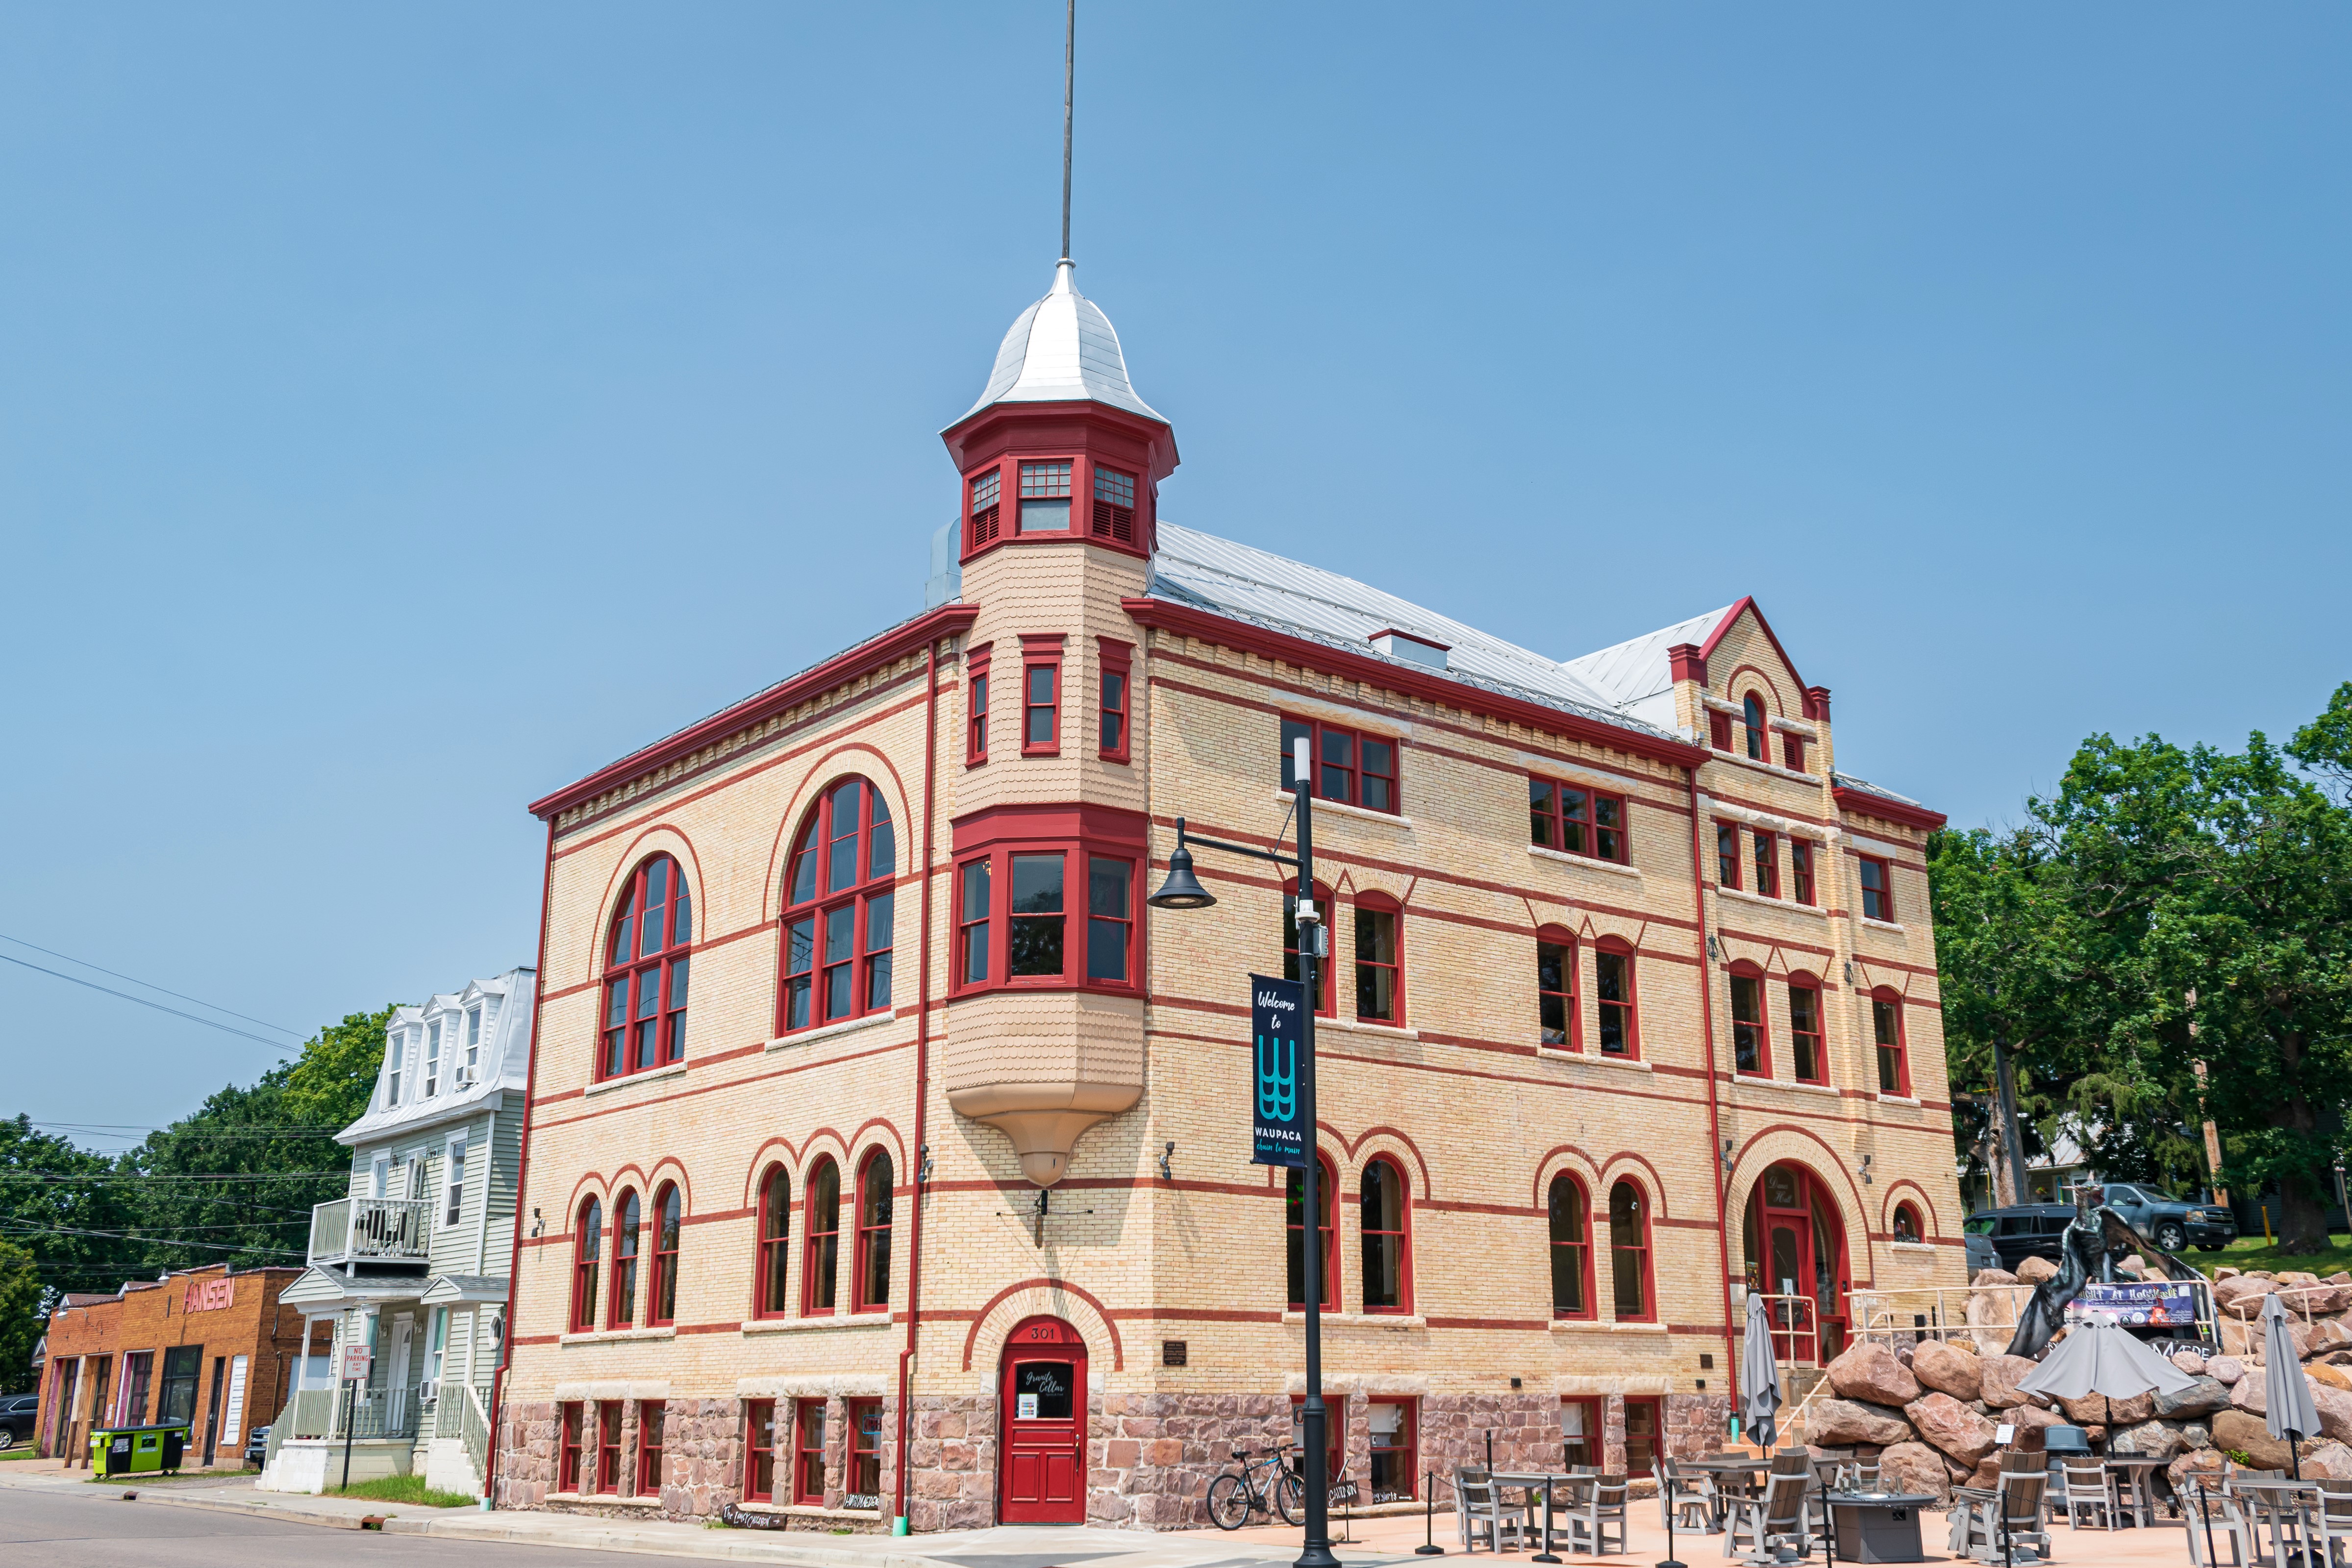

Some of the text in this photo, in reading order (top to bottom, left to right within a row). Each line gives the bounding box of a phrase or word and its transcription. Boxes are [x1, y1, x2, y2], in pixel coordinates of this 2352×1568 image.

[1258, 991, 1295, 1011] Welcome
[1271, 1014, 1281, 1029] to
[1255, 1126, 1301, 1142] WAUPACA
[1256, 1138, 1300, 1155] chain to main
[182, 1278, 235, 1315] HANSEN
[1031, 1327, 1054, 1339] 301
[1039, 1381, 1064, 1393] Cellar
[724, 1505, 733, 1519] The
